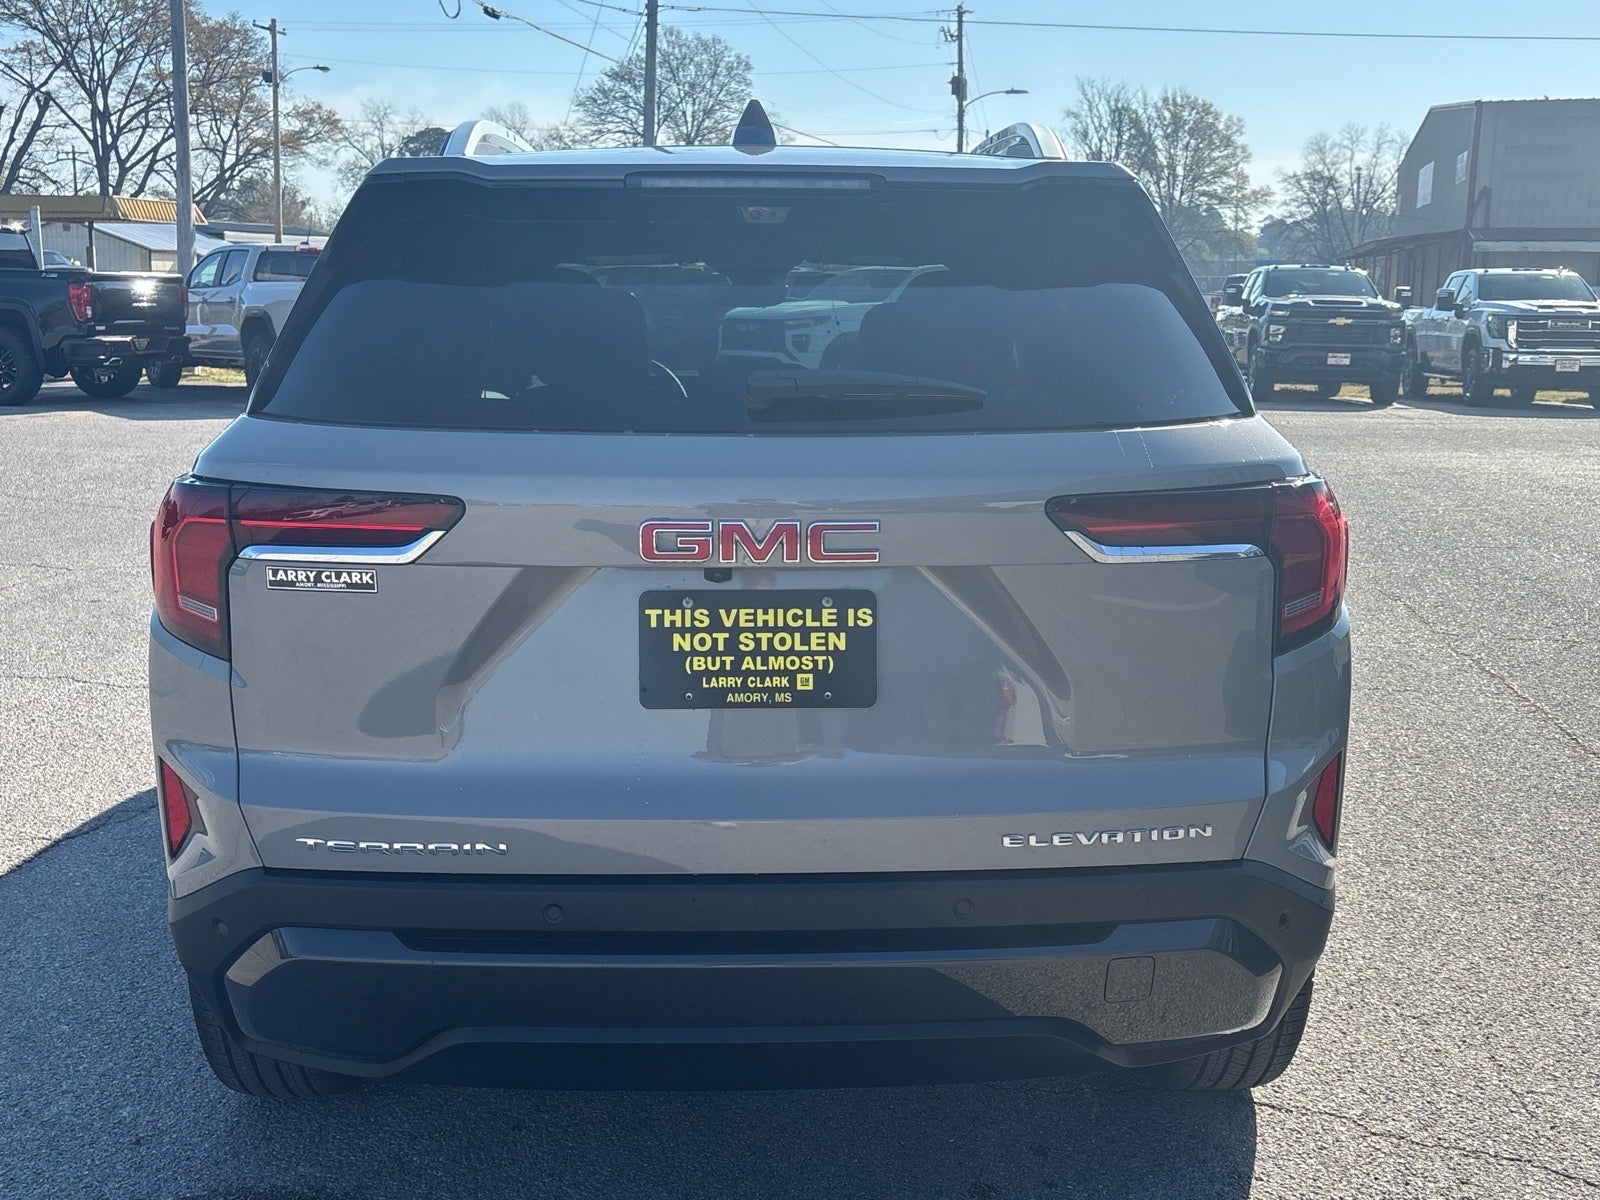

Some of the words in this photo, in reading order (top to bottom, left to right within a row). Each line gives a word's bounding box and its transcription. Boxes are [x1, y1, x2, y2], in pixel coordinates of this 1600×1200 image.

[639, 519, 880, 563] GMC
[268, 569, 317, 582] LARRY
[321, 572, 374, 584] CLARK
[644, 608, 710, 628] THIS
[719, 608, 838, 628] VEHICLE
[847, 608, 874, 627] IS
[672, 632, 729, 652] NOT
[738, 632, 846, 651] STOLEN
[685, 656, 735, 674] (BUT
[741, 656, 834, 674] ALMOST)
[702, 677, 743, 688] LARRY
[747, 677, 790, 688] CLARK
[726, 693, 772, 704] AMORY,
[775, 693, 793, 703] MS
[1001, 824, 1213, 848] ELEVATION
[295, 838, 509, 856] TERRAIN
